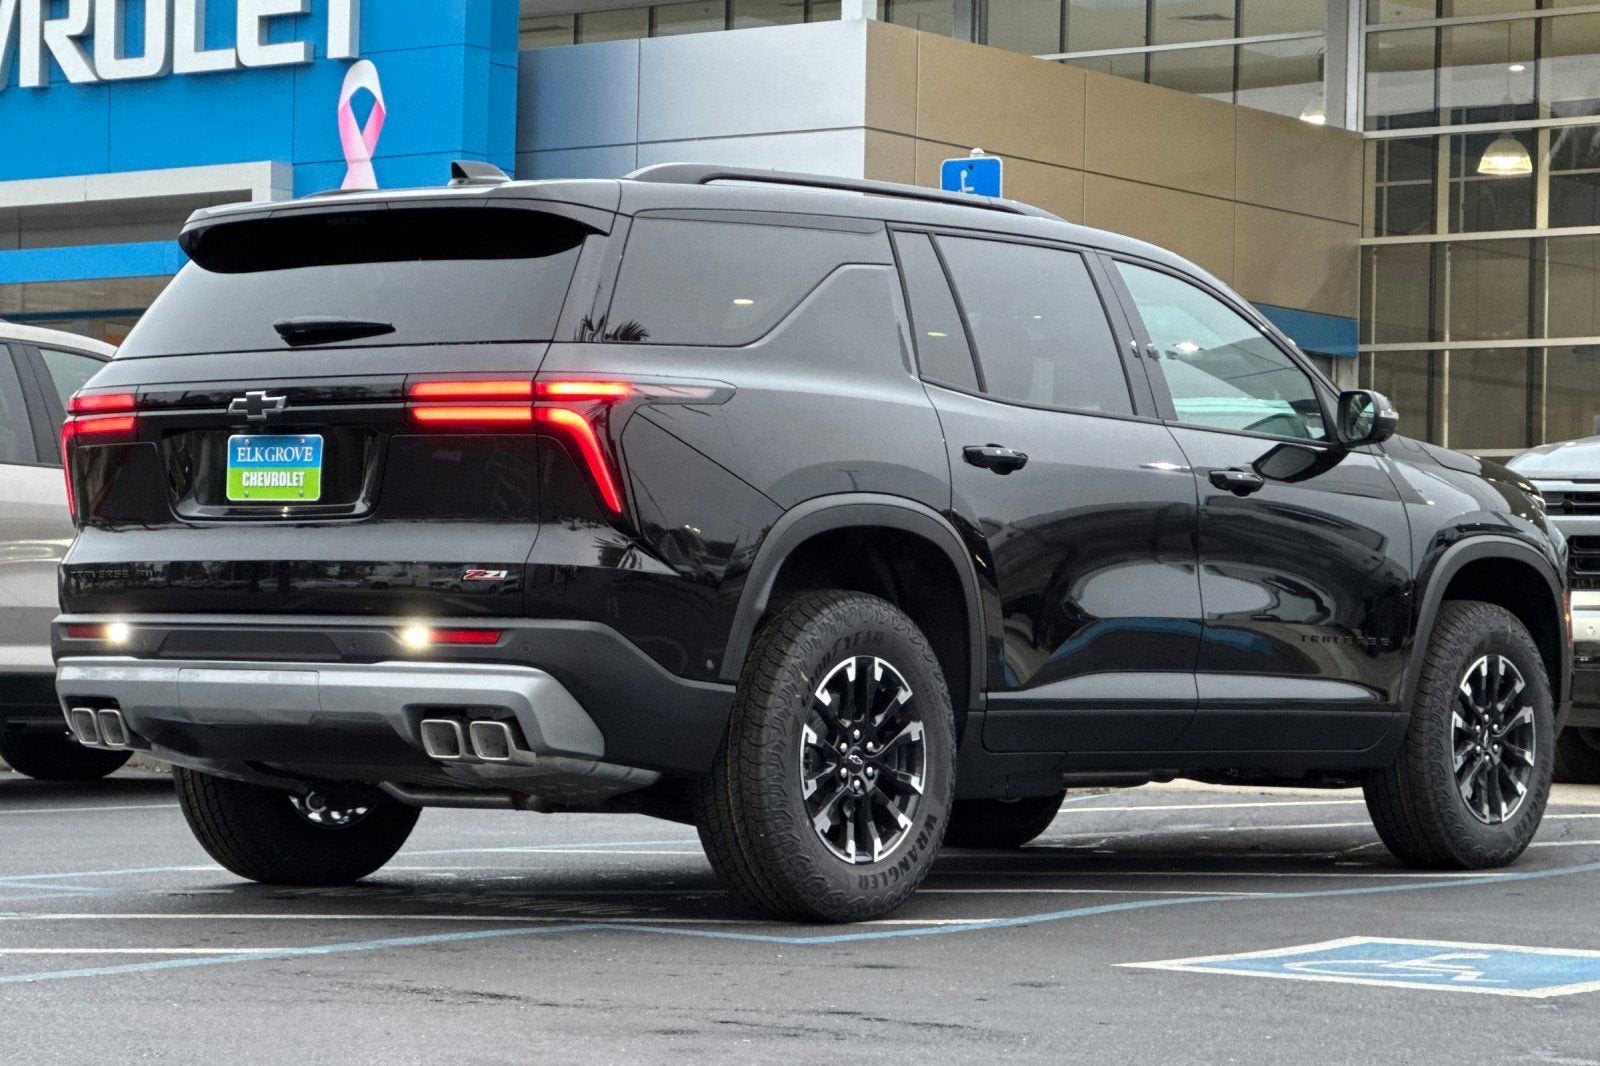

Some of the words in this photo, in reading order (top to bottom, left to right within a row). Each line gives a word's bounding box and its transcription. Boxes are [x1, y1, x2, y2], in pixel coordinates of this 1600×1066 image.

[0, 0, 360, 91] ROLE
[237, 447, 265, 462] ELK
[265, 446, 313, 462] GROVE
[242, 471, 305, 487] CHEVROLET
[463, 569, 508, 580] Z71
[858, 814, 938, 890] WRANGLER
